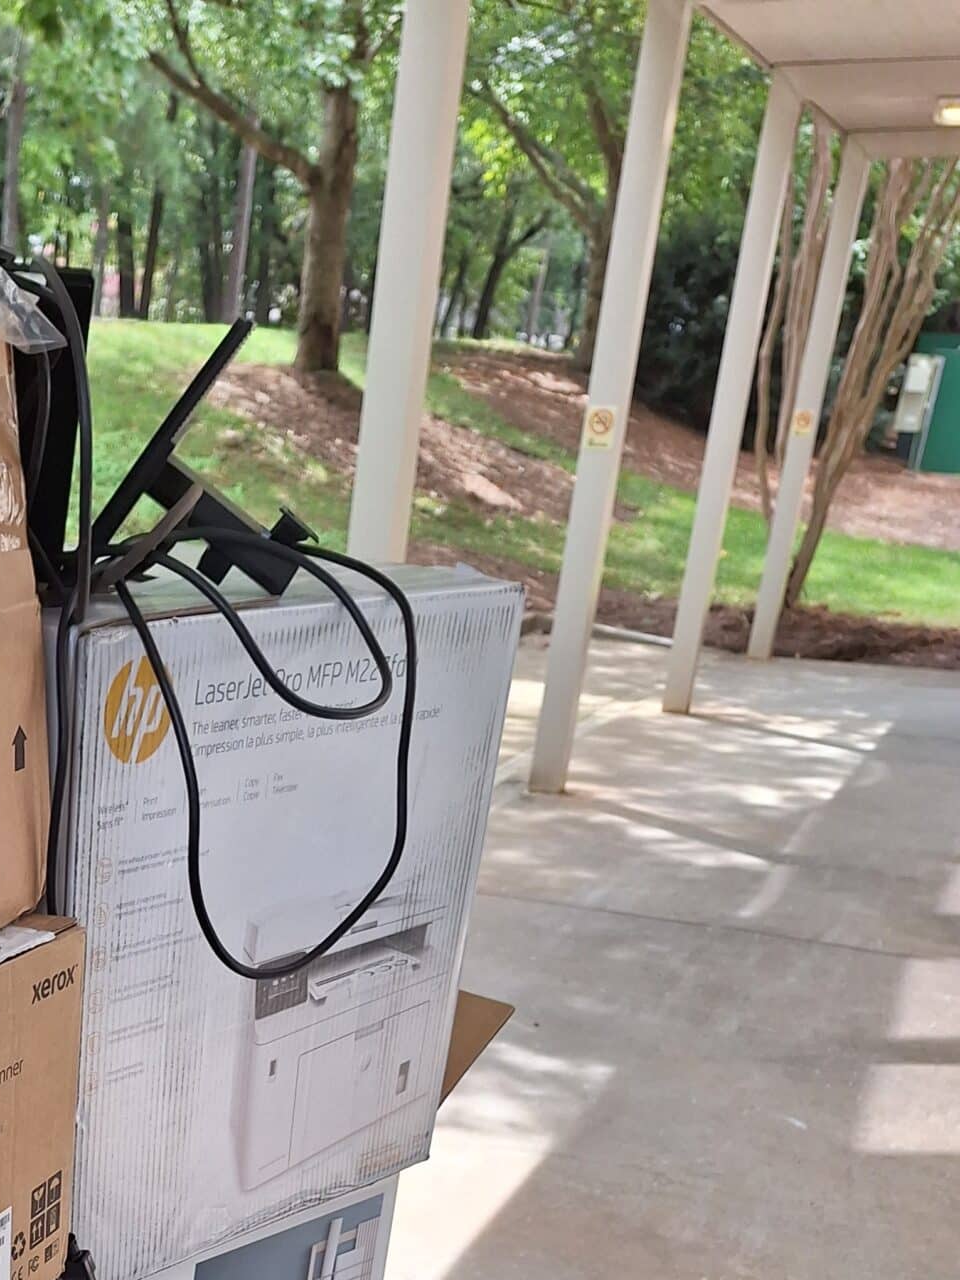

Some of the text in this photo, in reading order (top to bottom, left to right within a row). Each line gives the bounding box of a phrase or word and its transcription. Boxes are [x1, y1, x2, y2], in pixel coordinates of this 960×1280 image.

[194, 672, 268, 705] LaserJet
[306, 662, 343, 689] MFP
[104, 655, 170, 763] hp
[192, 720, 209, 736] The
[32, 966, 77, 1004] xerox
